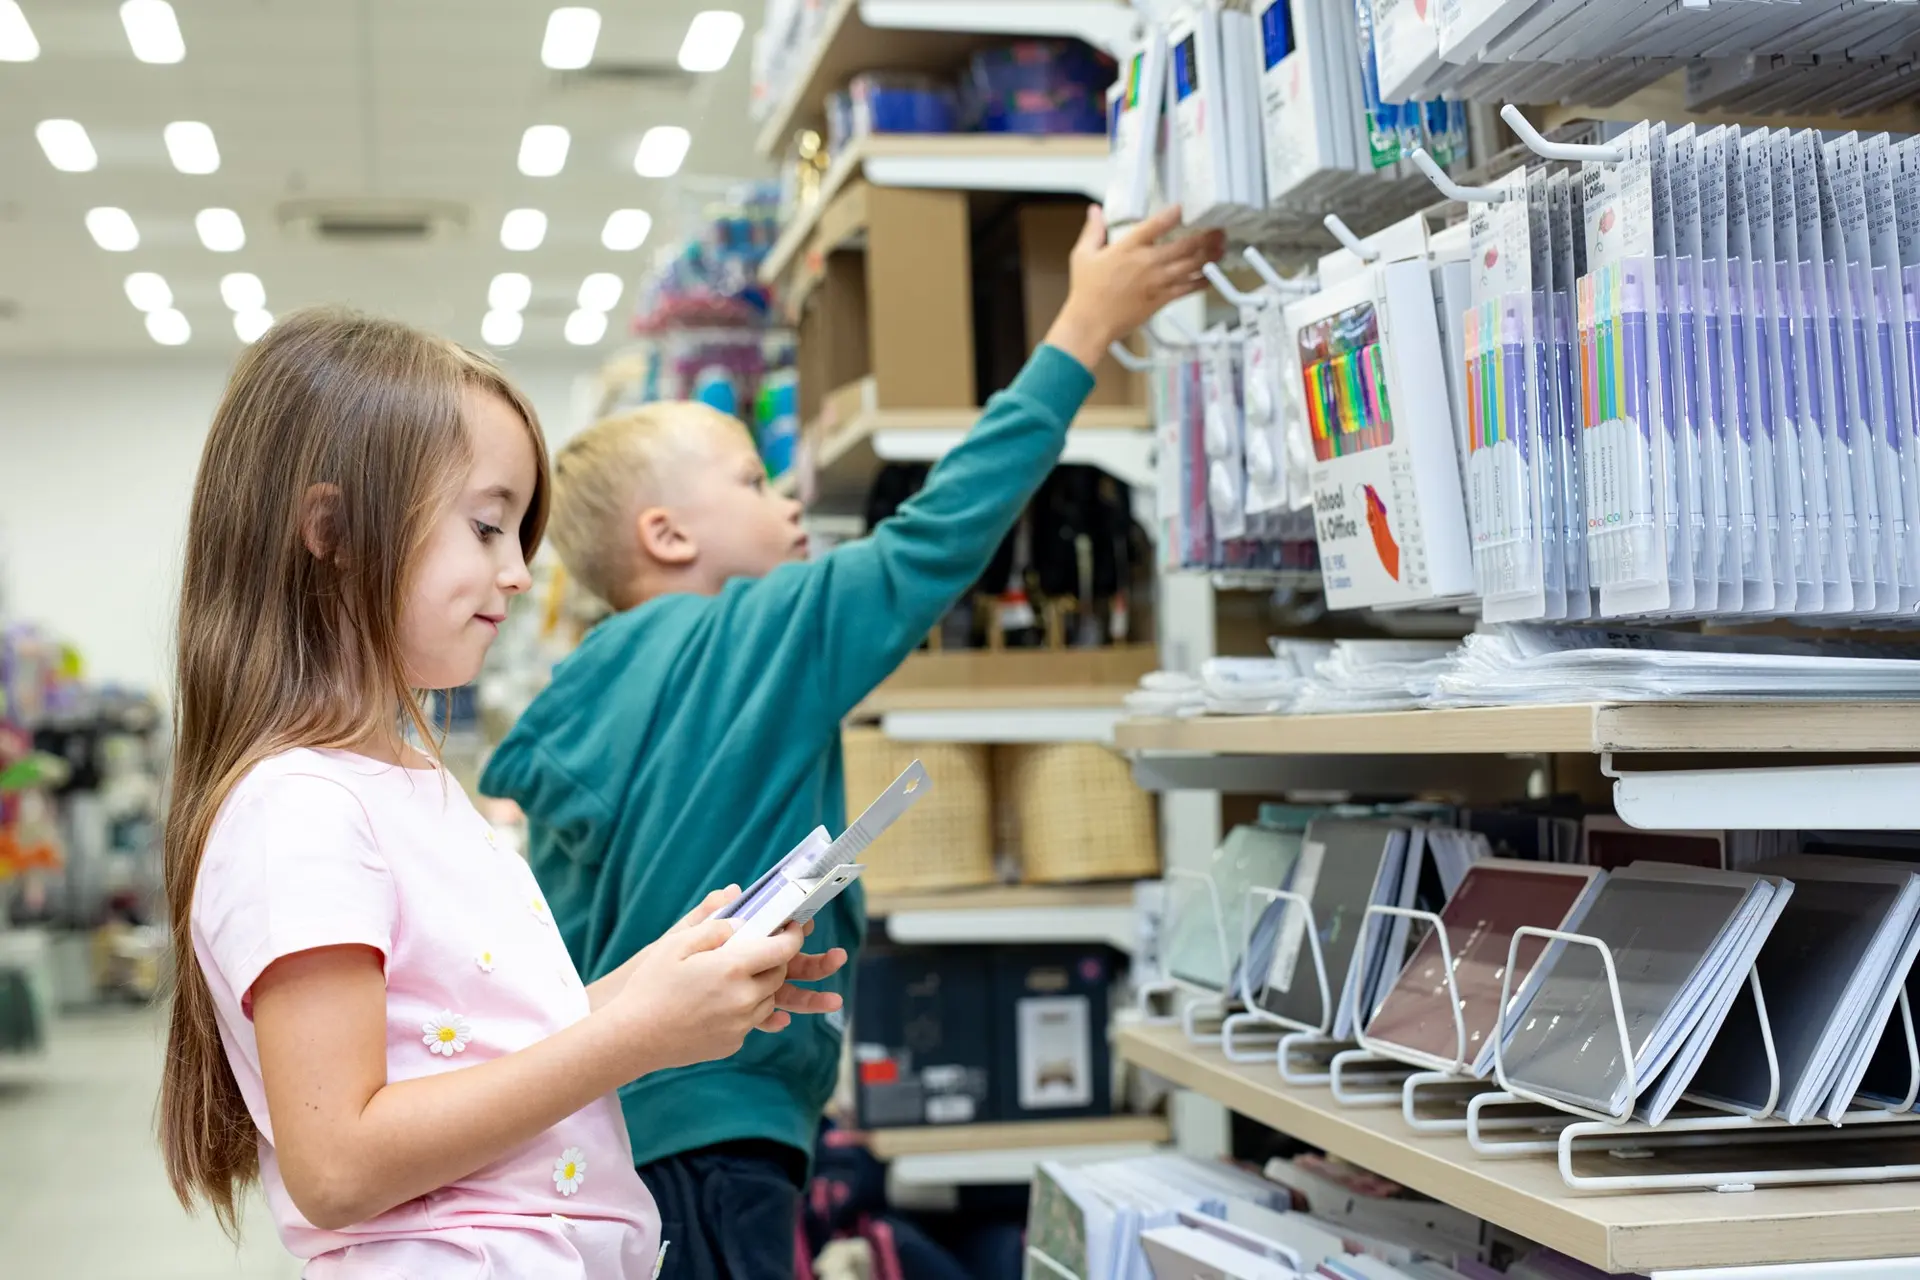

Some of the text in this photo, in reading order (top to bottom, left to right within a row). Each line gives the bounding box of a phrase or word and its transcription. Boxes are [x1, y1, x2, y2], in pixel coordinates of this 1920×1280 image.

[1584, 165, 1601, 187] School
[1584, 181, 1605, 202] & Office
[1855, 196, 1863, 205] 200
[1883, 199, 1891, 208] 200
[1856, 212, 1865, 222] 600
[1884, 215, 1893, 224] 600
[1314, 482, 1345, 512] School
[1327, 514, 1358, 542] Office
